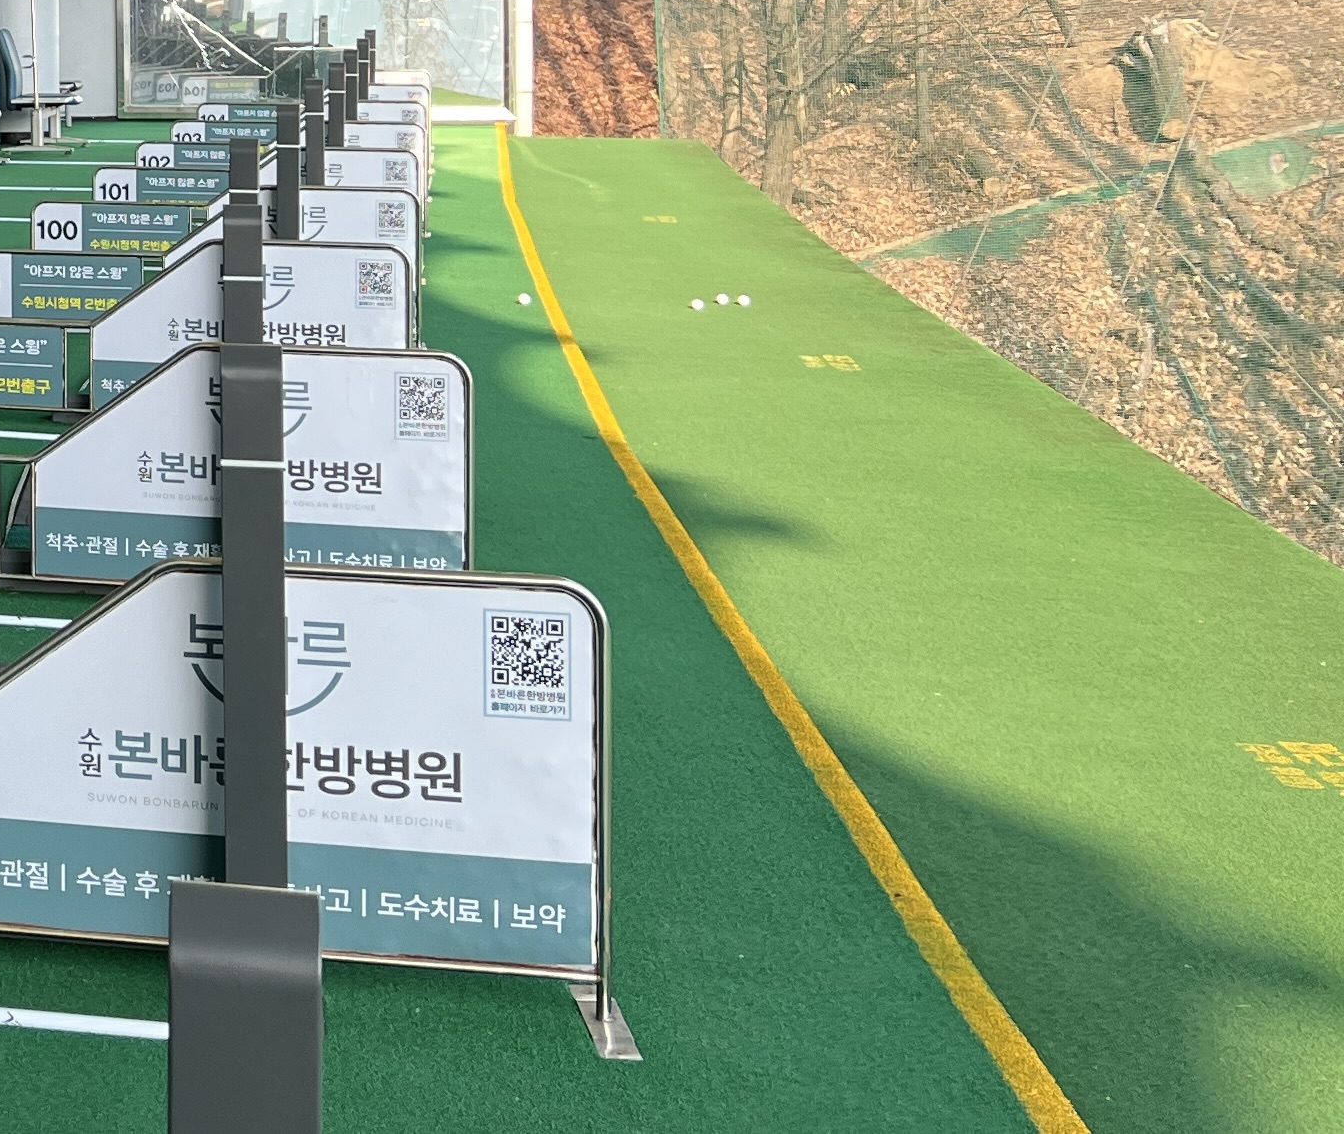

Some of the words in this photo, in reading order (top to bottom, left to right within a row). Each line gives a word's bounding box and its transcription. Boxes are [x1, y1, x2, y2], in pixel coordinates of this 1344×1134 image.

[139, 155, 171, 167] 102
[177, 177, 196, 188] 않은
[99, 183, 130, 200] 101
[129, 213, 151, 226] 않은
[36, 220, 78, 240] 100
[89, 238, 140, 252] 수원시청역
[142, 240, 176, 252] 2번출
[69, 265, 94, 280] 않은
[21, 295, 82, 311] 수원시청역
[136, 450, 154, 483] 수원
[135, 538, 170, 560] 수술
[172, 541, 191, 559] 후
[497, 688, 566, 703] 본바른한방병원
[491, 701, 527, 713] 홈페이지
[530, 704, 566, 715] 바로가기
[77, 727, 103, 779] 수원
[87, 791, 138, 806] SUWON
[142, 796, 220, 812] BONBARUN
[297, 808, 317, 820] OF
[321, 809, 379, 825] KOREAN
[383, 814, 454, 830] MEDICINE
[75, 866, 129, 898] 수술
[133, 869, 161, 900] 후
[376, 888, 484, 925] 도수치료
[510, 902, 567, 934] 보약
